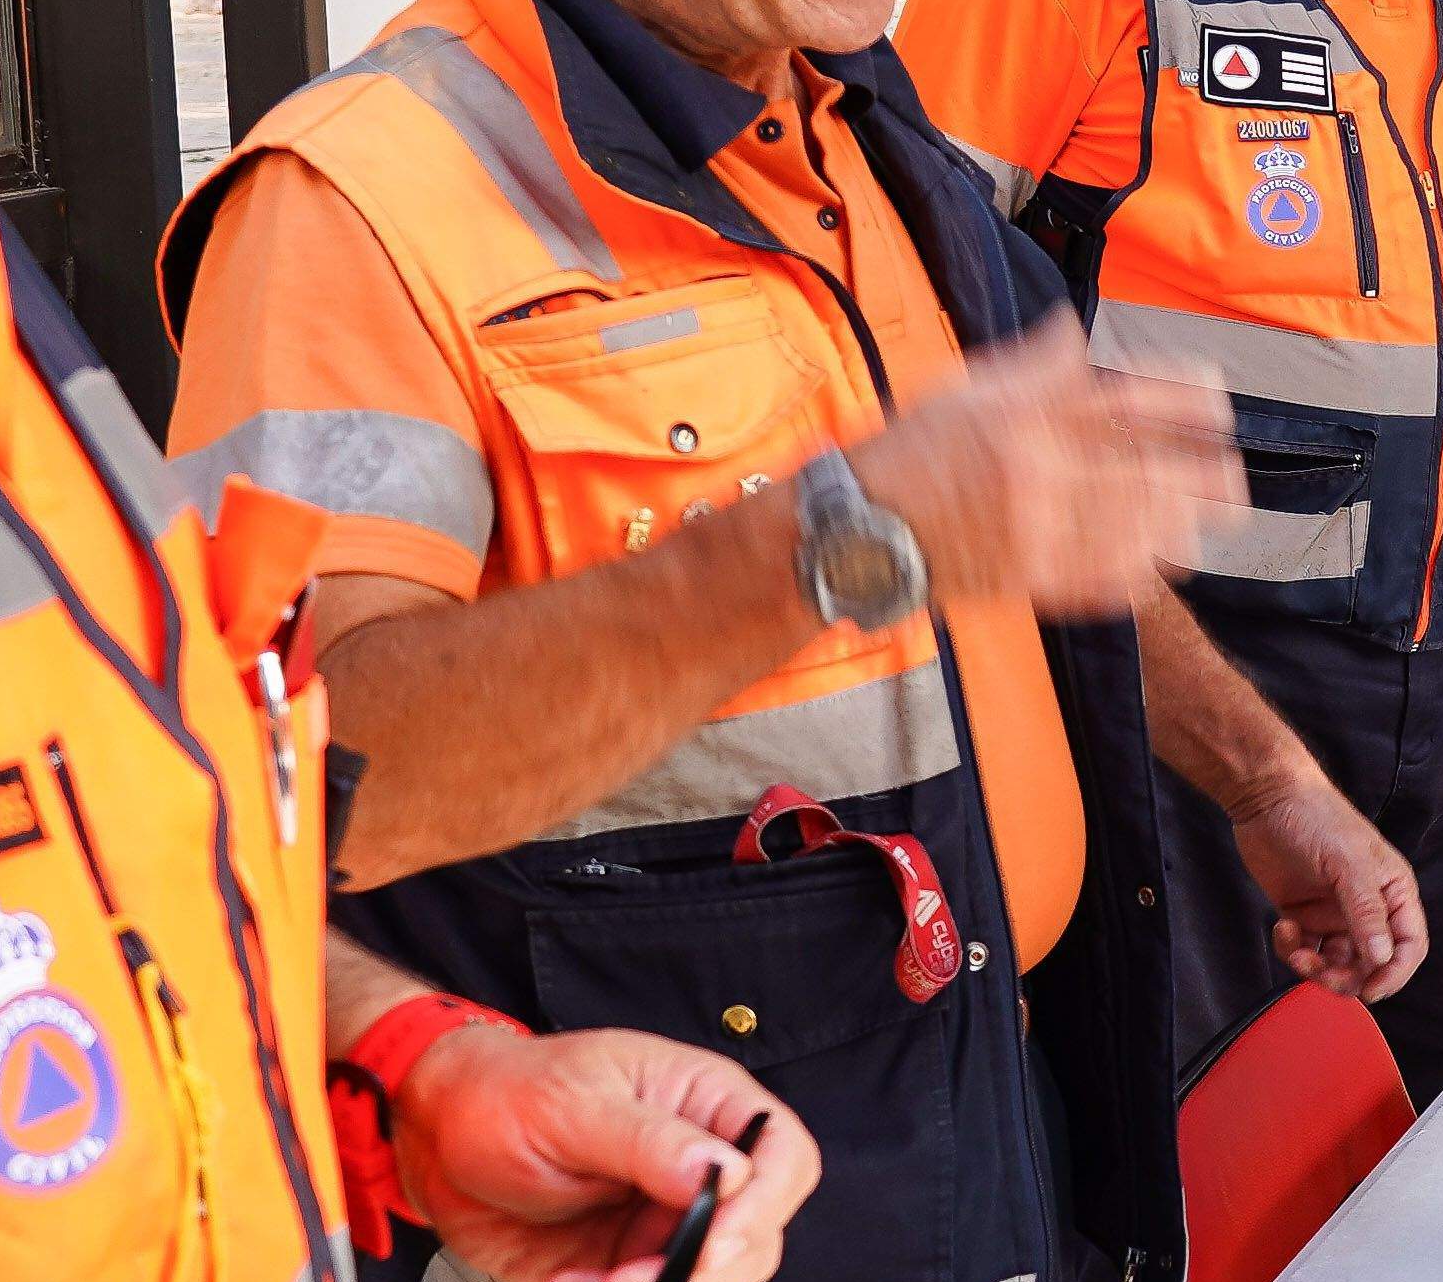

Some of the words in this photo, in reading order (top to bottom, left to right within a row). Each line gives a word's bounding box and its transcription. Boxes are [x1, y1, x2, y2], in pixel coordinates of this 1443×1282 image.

[1239, 120, 1308, 139] 24001067
[1252, 179, 1315, 205] PROTECCION
[1265, 229, 1305, 245] CIVIL
